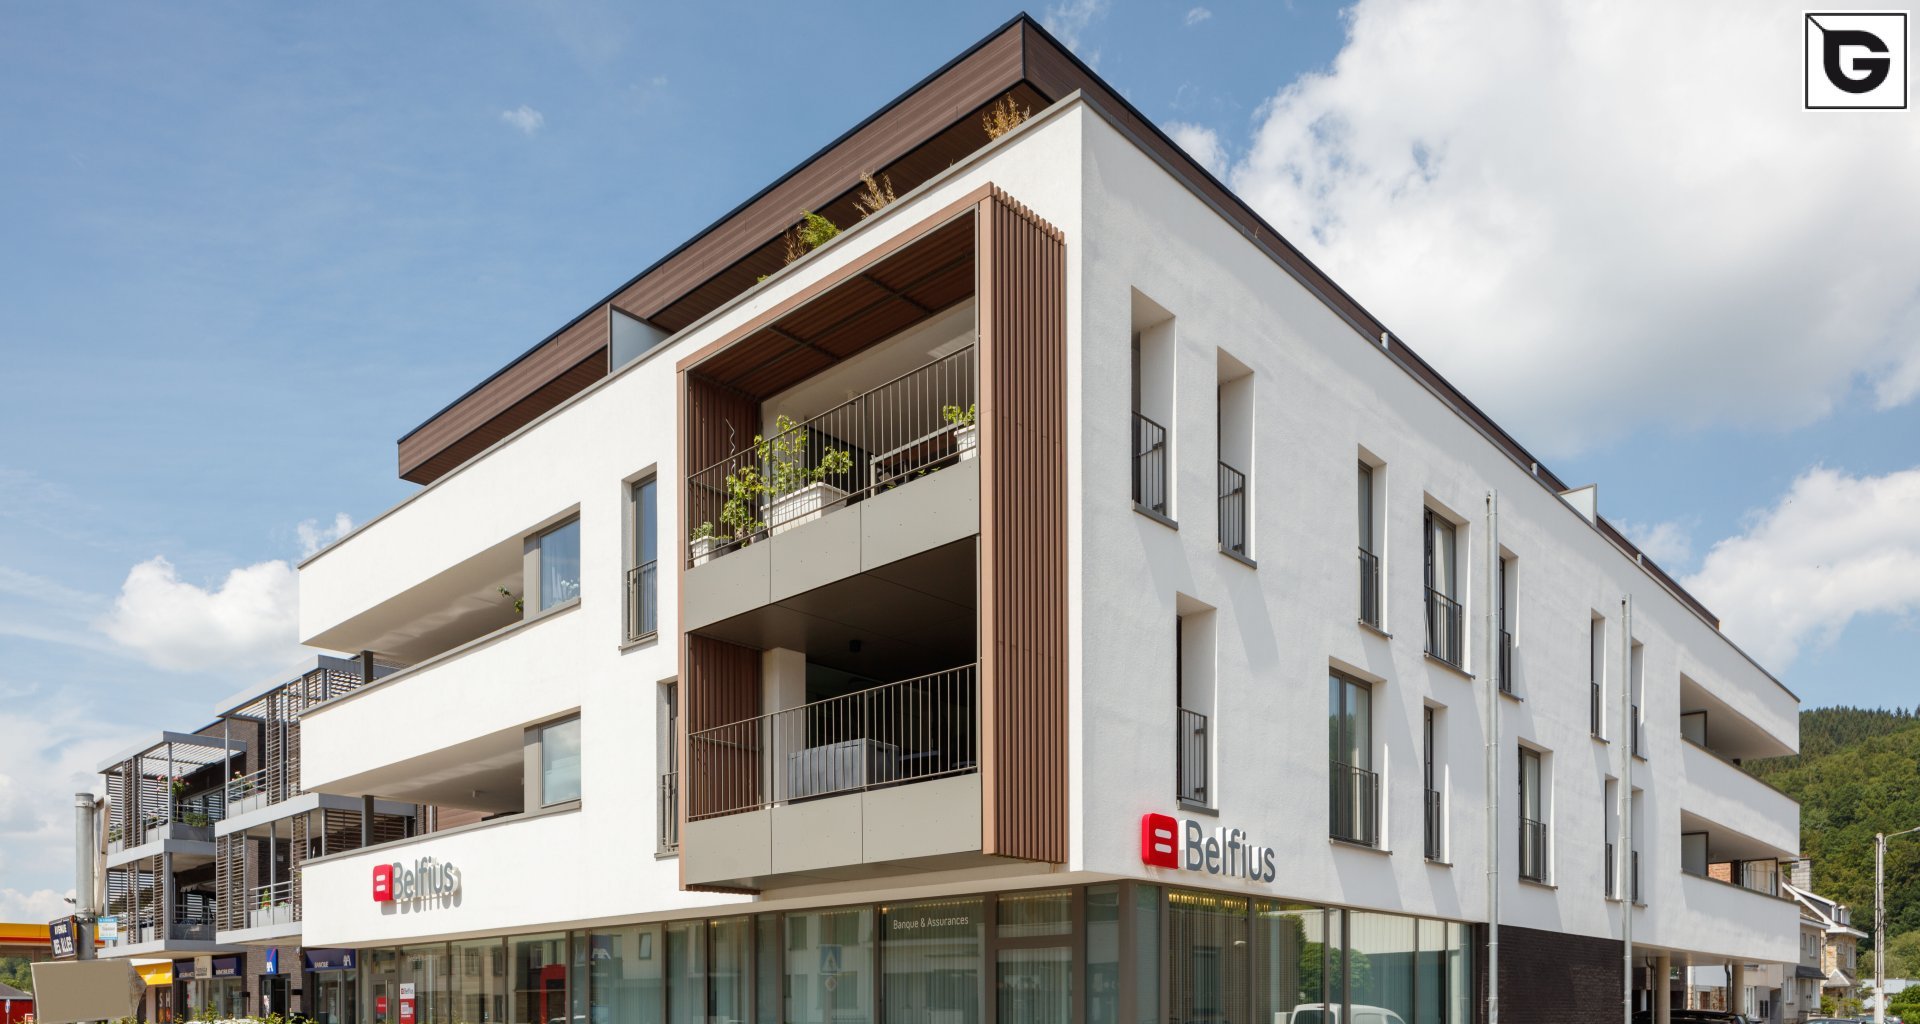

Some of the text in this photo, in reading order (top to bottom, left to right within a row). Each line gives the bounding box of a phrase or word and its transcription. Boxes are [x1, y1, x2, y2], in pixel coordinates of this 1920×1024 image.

[1184, 819, 1276, 883] Belfius
[393, 856, 455, 900] Belfius
[893, 916, 969, 930] Banque & Assurances
